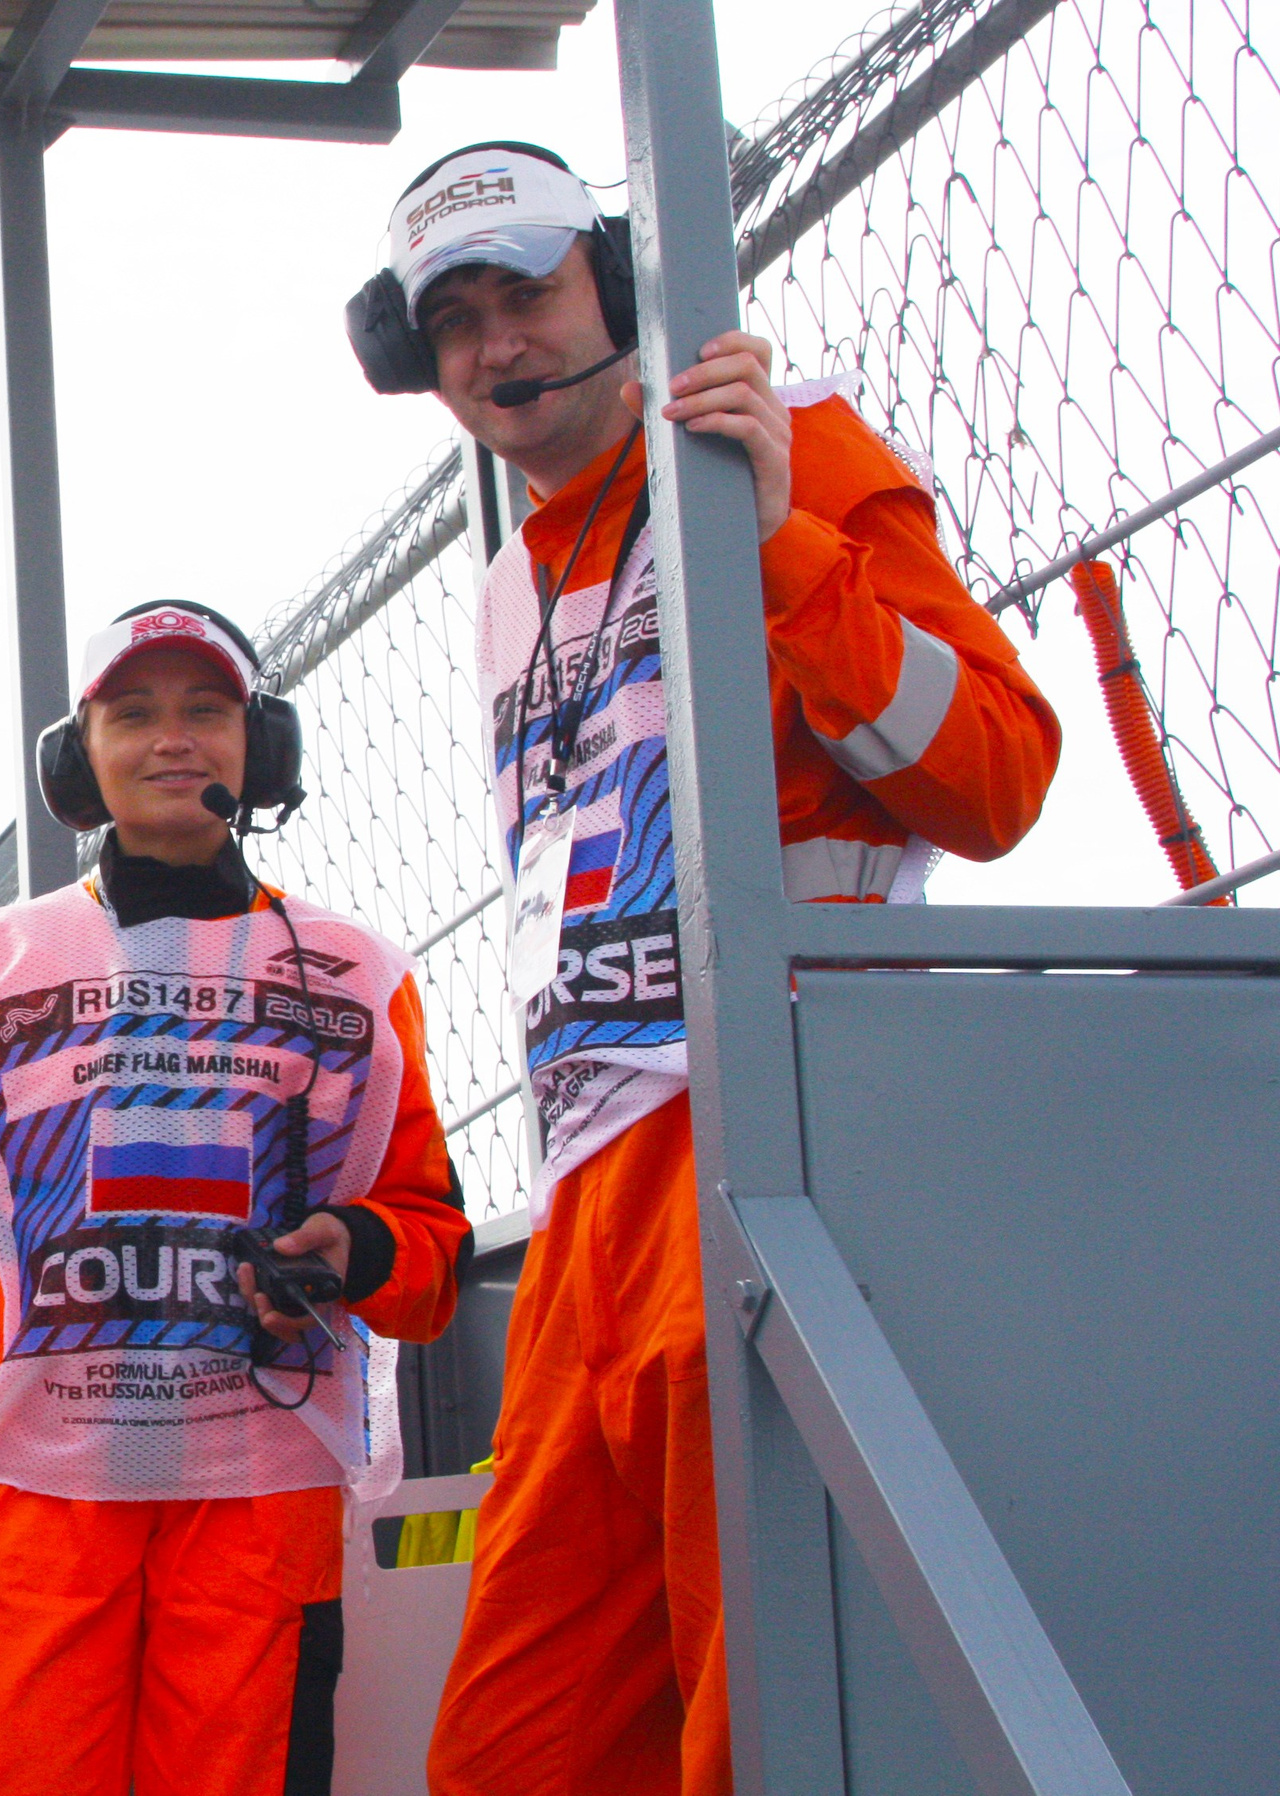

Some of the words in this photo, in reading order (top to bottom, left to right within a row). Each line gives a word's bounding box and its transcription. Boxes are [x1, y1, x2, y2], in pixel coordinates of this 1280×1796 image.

[406, 177, 515, 230] SOCHI
[407, 194, 516, 242] AUTODROM
[574, 661, 590, 701] SOCHI
[78, 979, 245, 1015] RUS1487
[265, 993, 367, 1040] 2018
[74, 1053, 128, 1084] CHIEF
[133, 1053, 180, 1073] FLAG
[187, 1055, 280, 1083] MARSHAL
[33, 1245, 246, 1308] COUR
[44, 1379, 83, 1400] VTB
[87, 1382, 174, 1400] RUSSIAN
[179, 1374, 245, 1399] GRAND
[86, 1363, 187, 1381] FORMULA
[191, 1361, 200, 1377] 1
[202, 1358, 243, 1376] 2018
